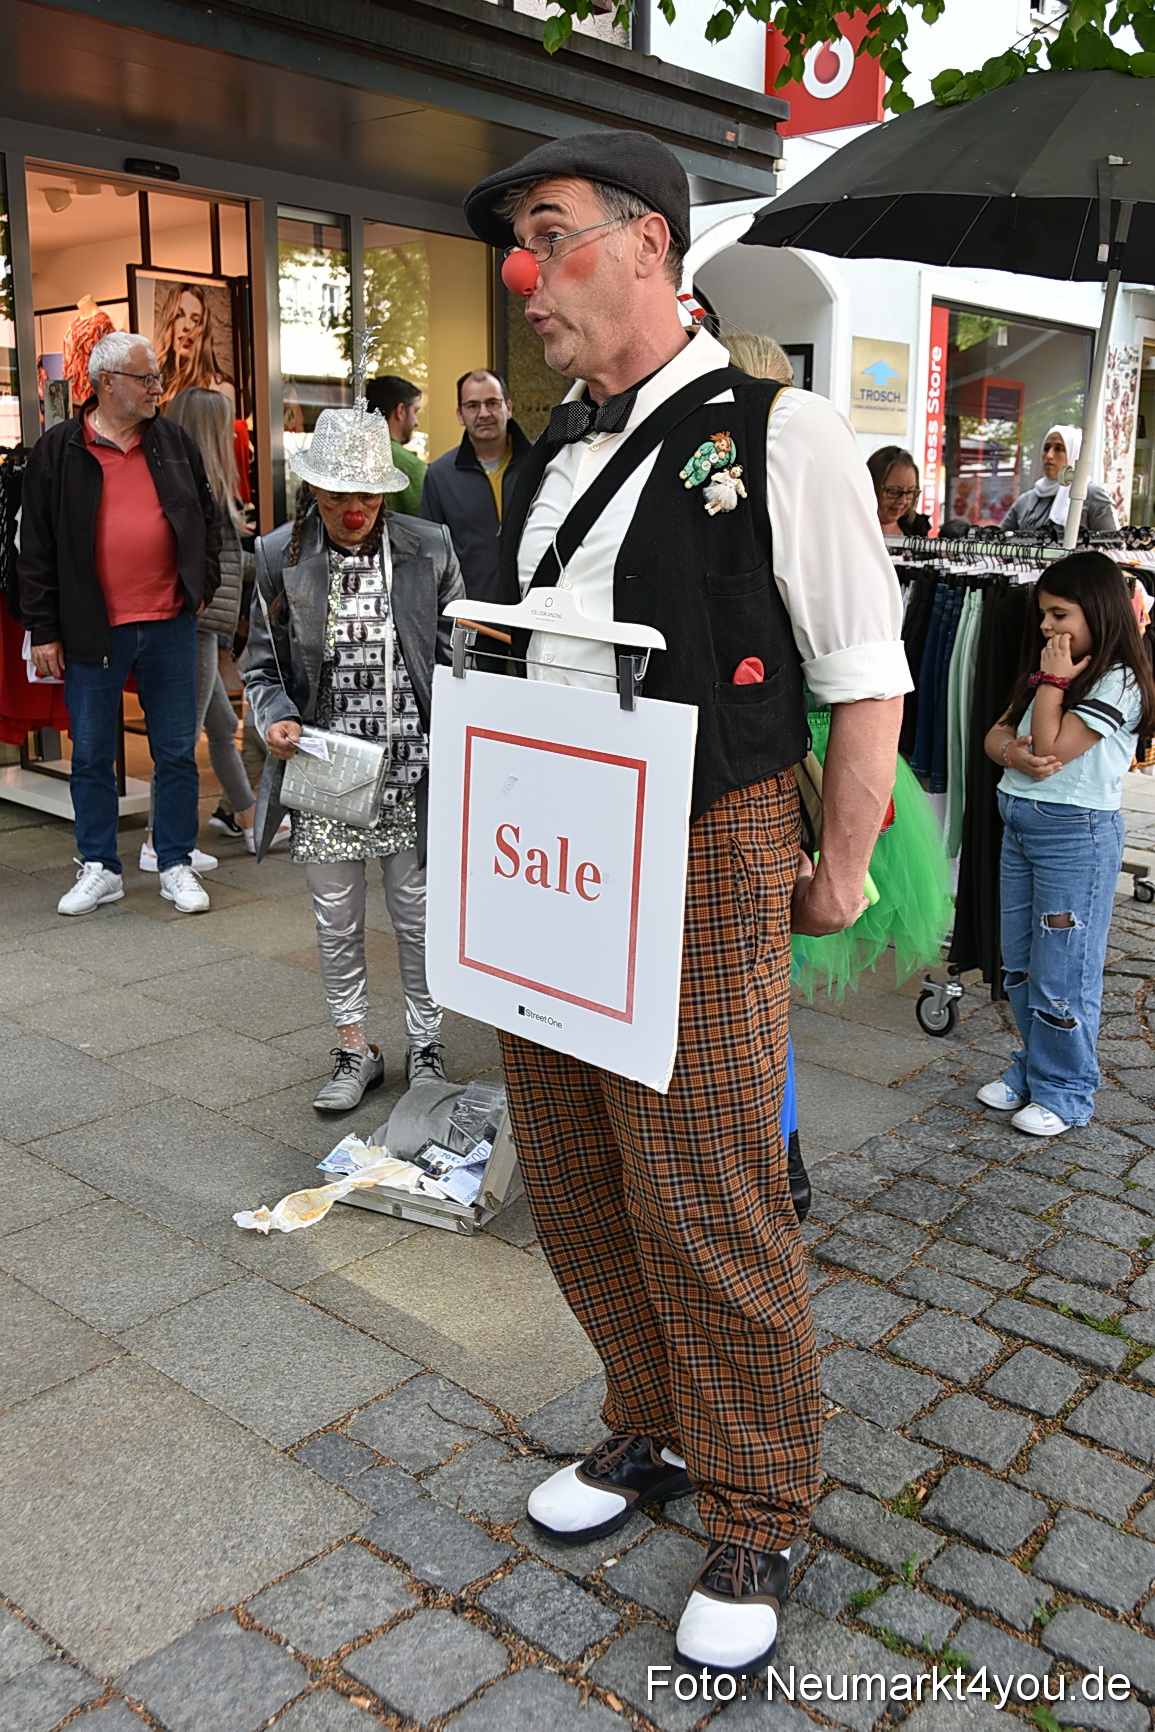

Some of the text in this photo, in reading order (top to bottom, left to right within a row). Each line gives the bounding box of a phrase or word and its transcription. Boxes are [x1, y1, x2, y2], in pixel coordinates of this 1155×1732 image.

[859, 388, 901, 403] TROSCH
[923, 345, 943, 529] usiness Store
[494, 823, 601, 901] Sale
[525, 1008, 563, 1029] Street One
[441, 1152, 452, 1160] 70
[465, 1147, 489, 1164] 500
